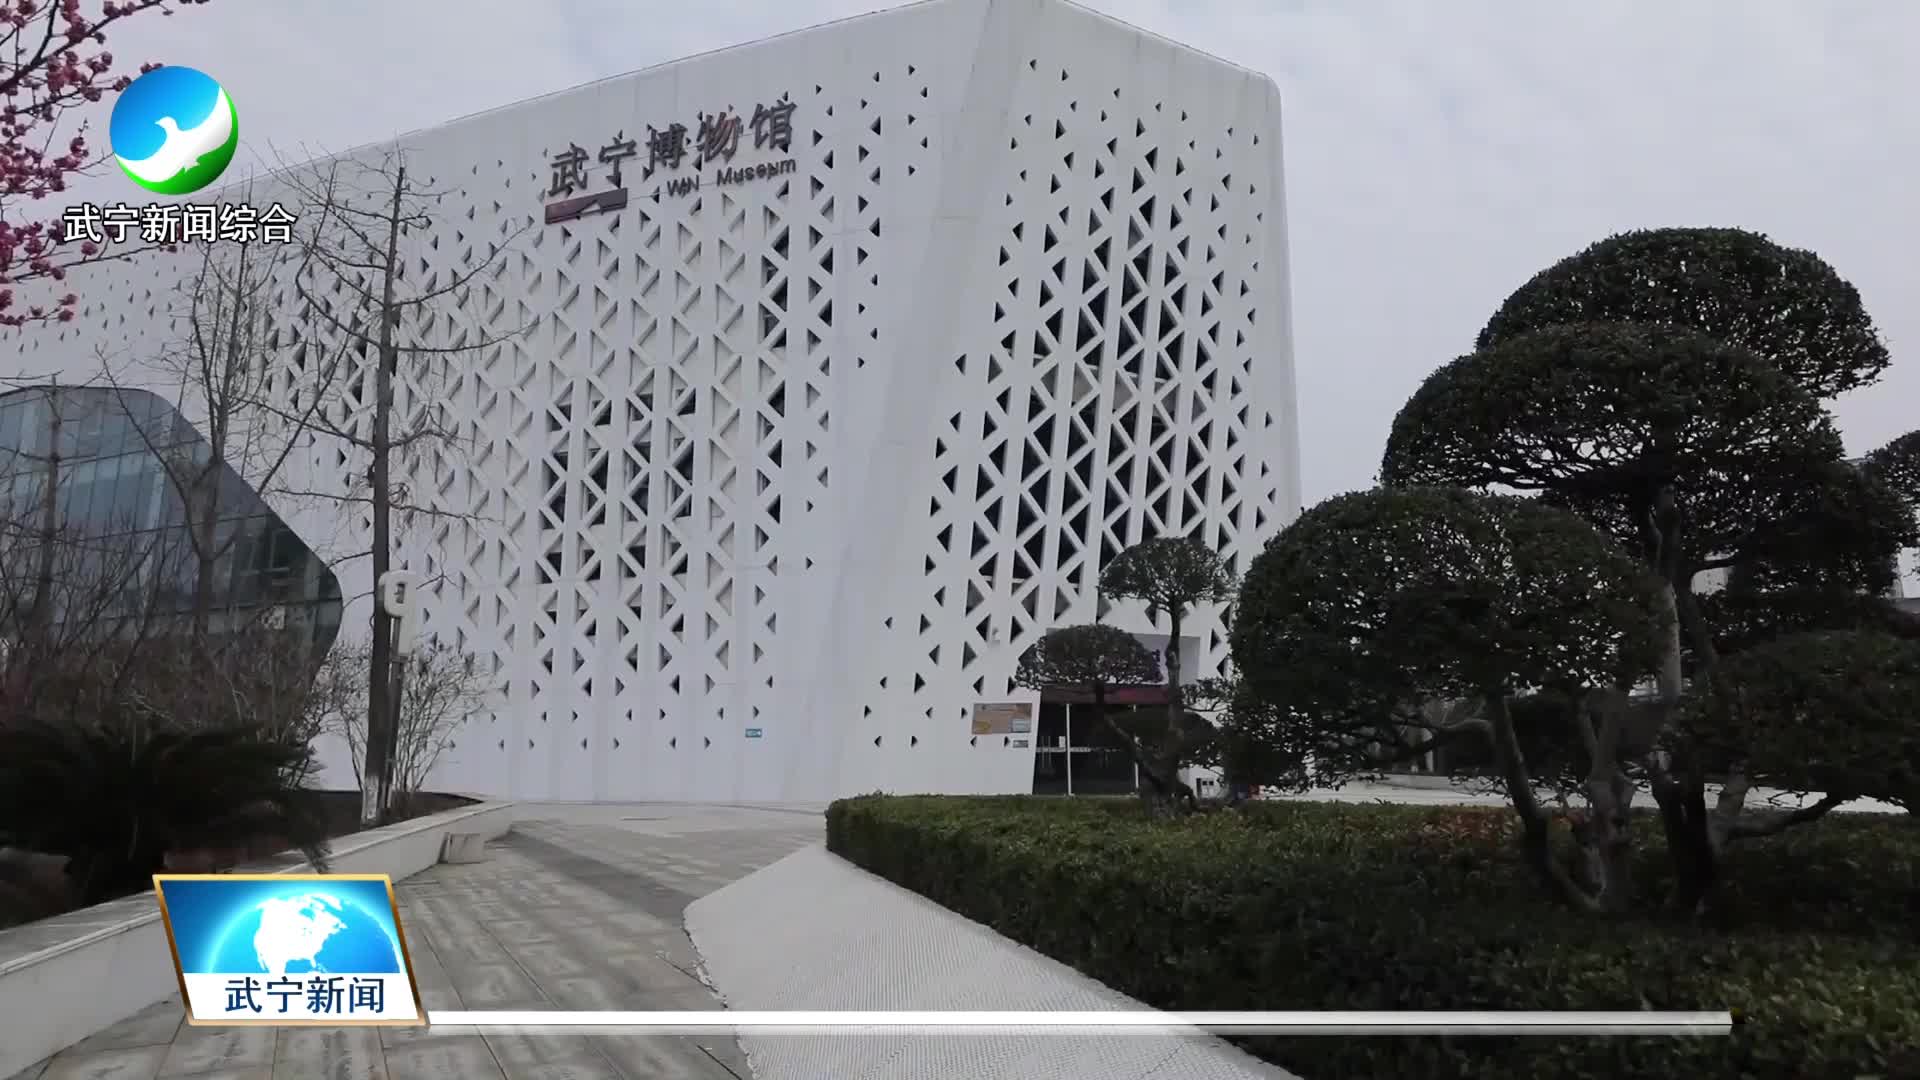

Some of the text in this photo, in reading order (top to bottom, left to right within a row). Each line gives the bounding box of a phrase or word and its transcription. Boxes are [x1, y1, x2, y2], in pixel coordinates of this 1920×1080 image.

[548, 98, 797, 197] 武宁博物馆
[716, 158, 797, 187] Museum
